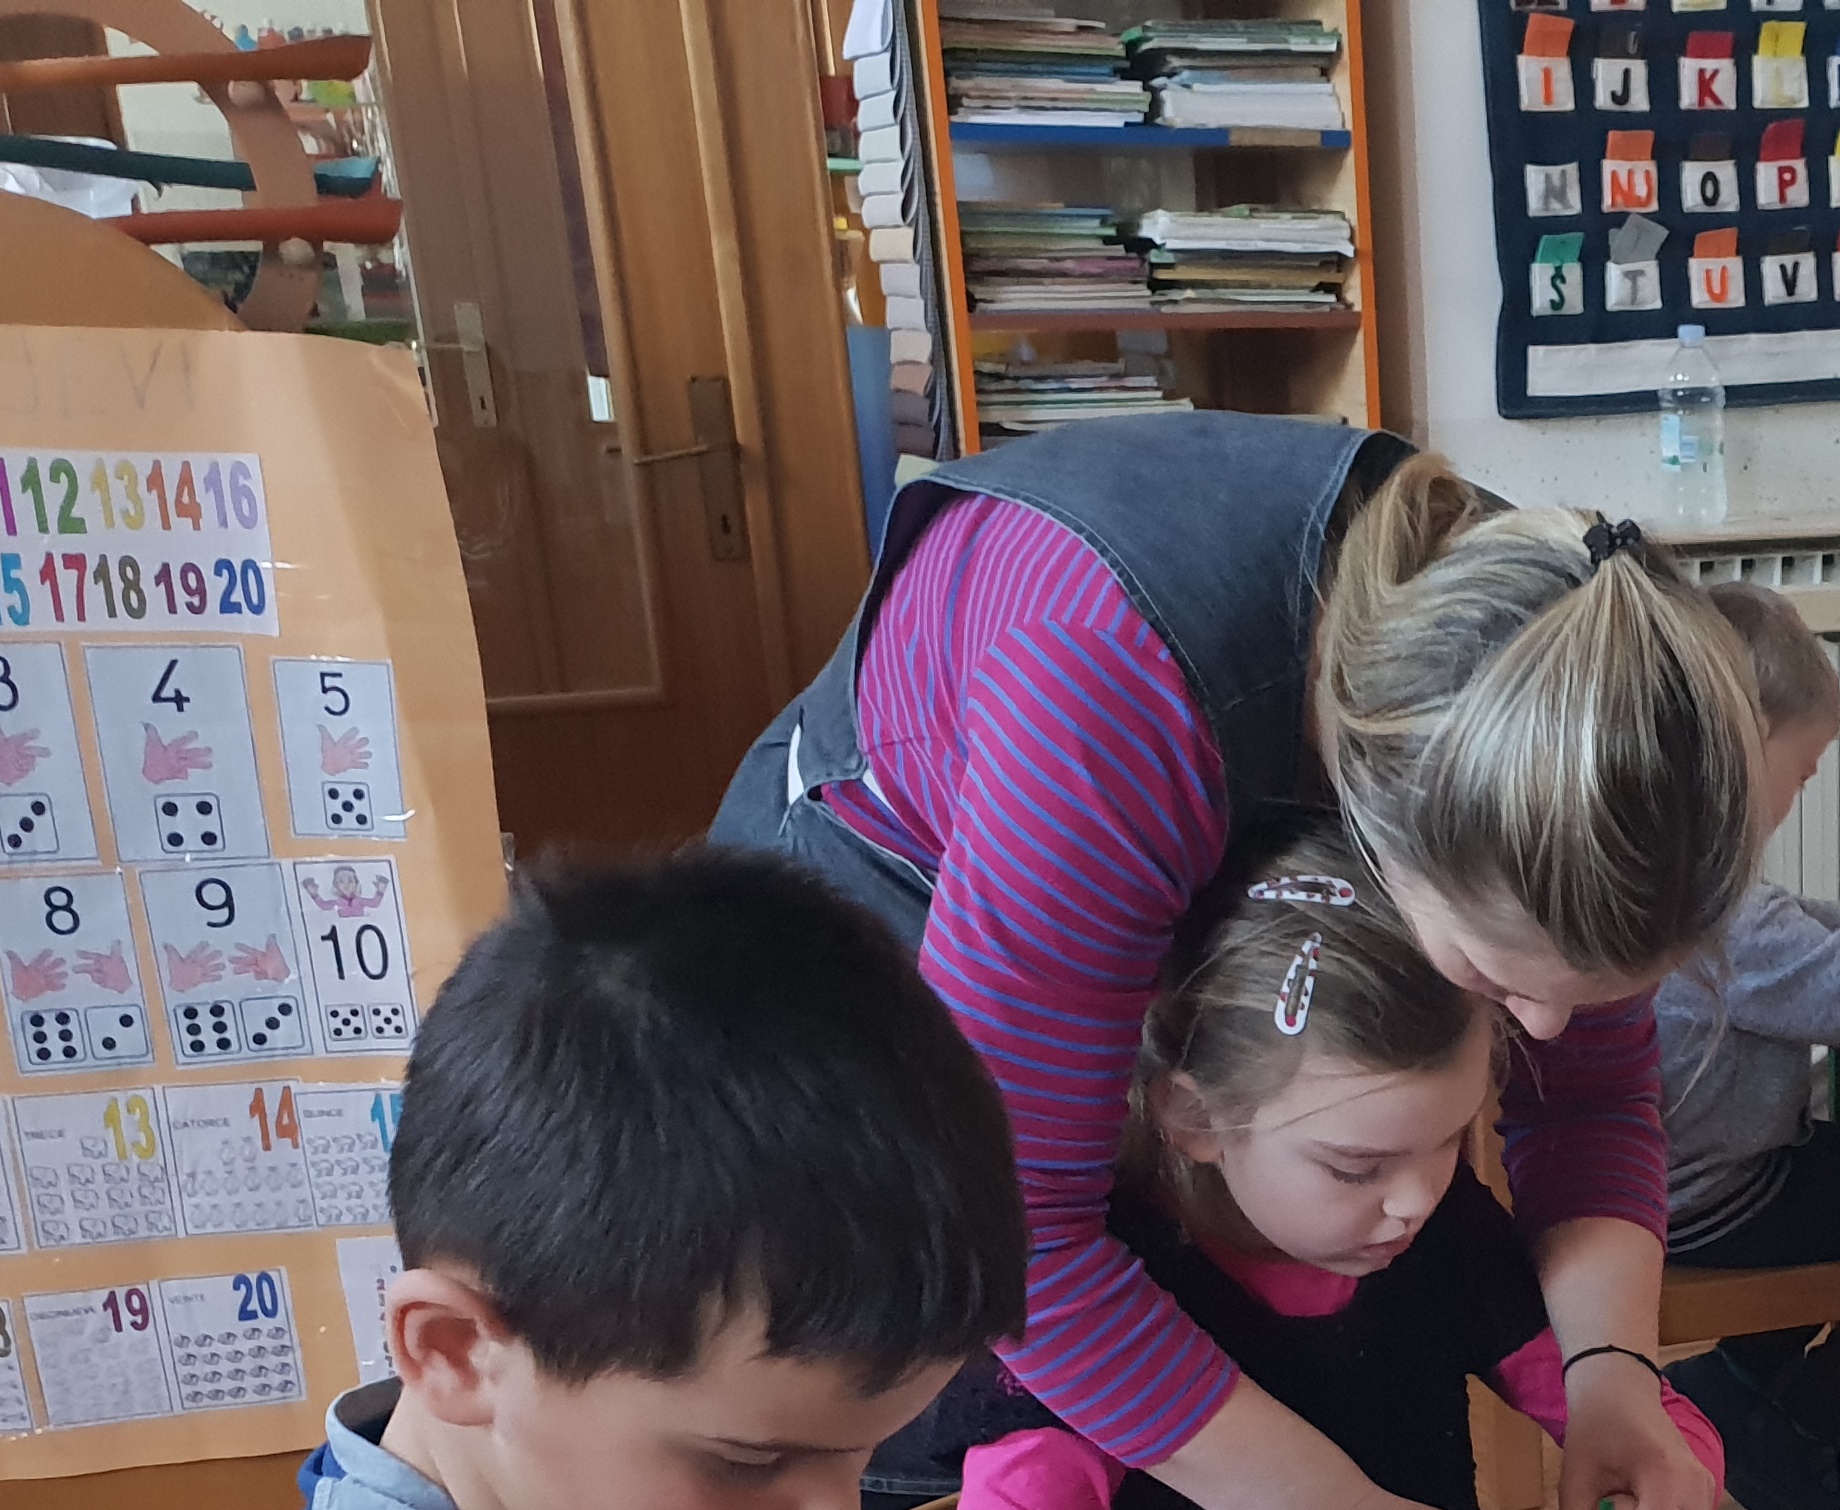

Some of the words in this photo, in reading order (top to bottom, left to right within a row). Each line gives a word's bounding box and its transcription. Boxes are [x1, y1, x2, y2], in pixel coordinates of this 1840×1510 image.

[1610, 68, 1631, 107] J
[1697, 69, 1722, 107] K
[1542, 170, 1570, 209] N
[1611, 169, 1653, 210] NJ
[1700, 172, 1719, 207] O
[1777, 166, 1798, 203] P
[1623, 270, 1645, 303] T
[1705, 266, 1729, 303] U
[1781, 263, 1801, 297] V
[20, 457, 88, 535] 12
[90, 458, 145, 530] 13
[146, 459, 202, 531] 14
[203, 460, 259, 530] 16
[0, 552, 31, 626] 5
[39, 552, 87, 623] 17
[93, 554, 147, 619] 18
[155, 562, 208, 615] 19
[214, 558, 266, 616] 20
[151, 659, 190, 713] 4
[319, 671, 351, 716] 5
[43, 886, 81, 935] 8
[195, 878, 236, 928] 9
[321, 924, 389, 981] 10
[103, 1094, 157, 1160] 13
[172, 1117, 231, 1131] CATORCE
[249, 1085, 299, 1151] 14
[102, 1287, 150, 1333] 19
[232, 1271, 279, 1321] 20
